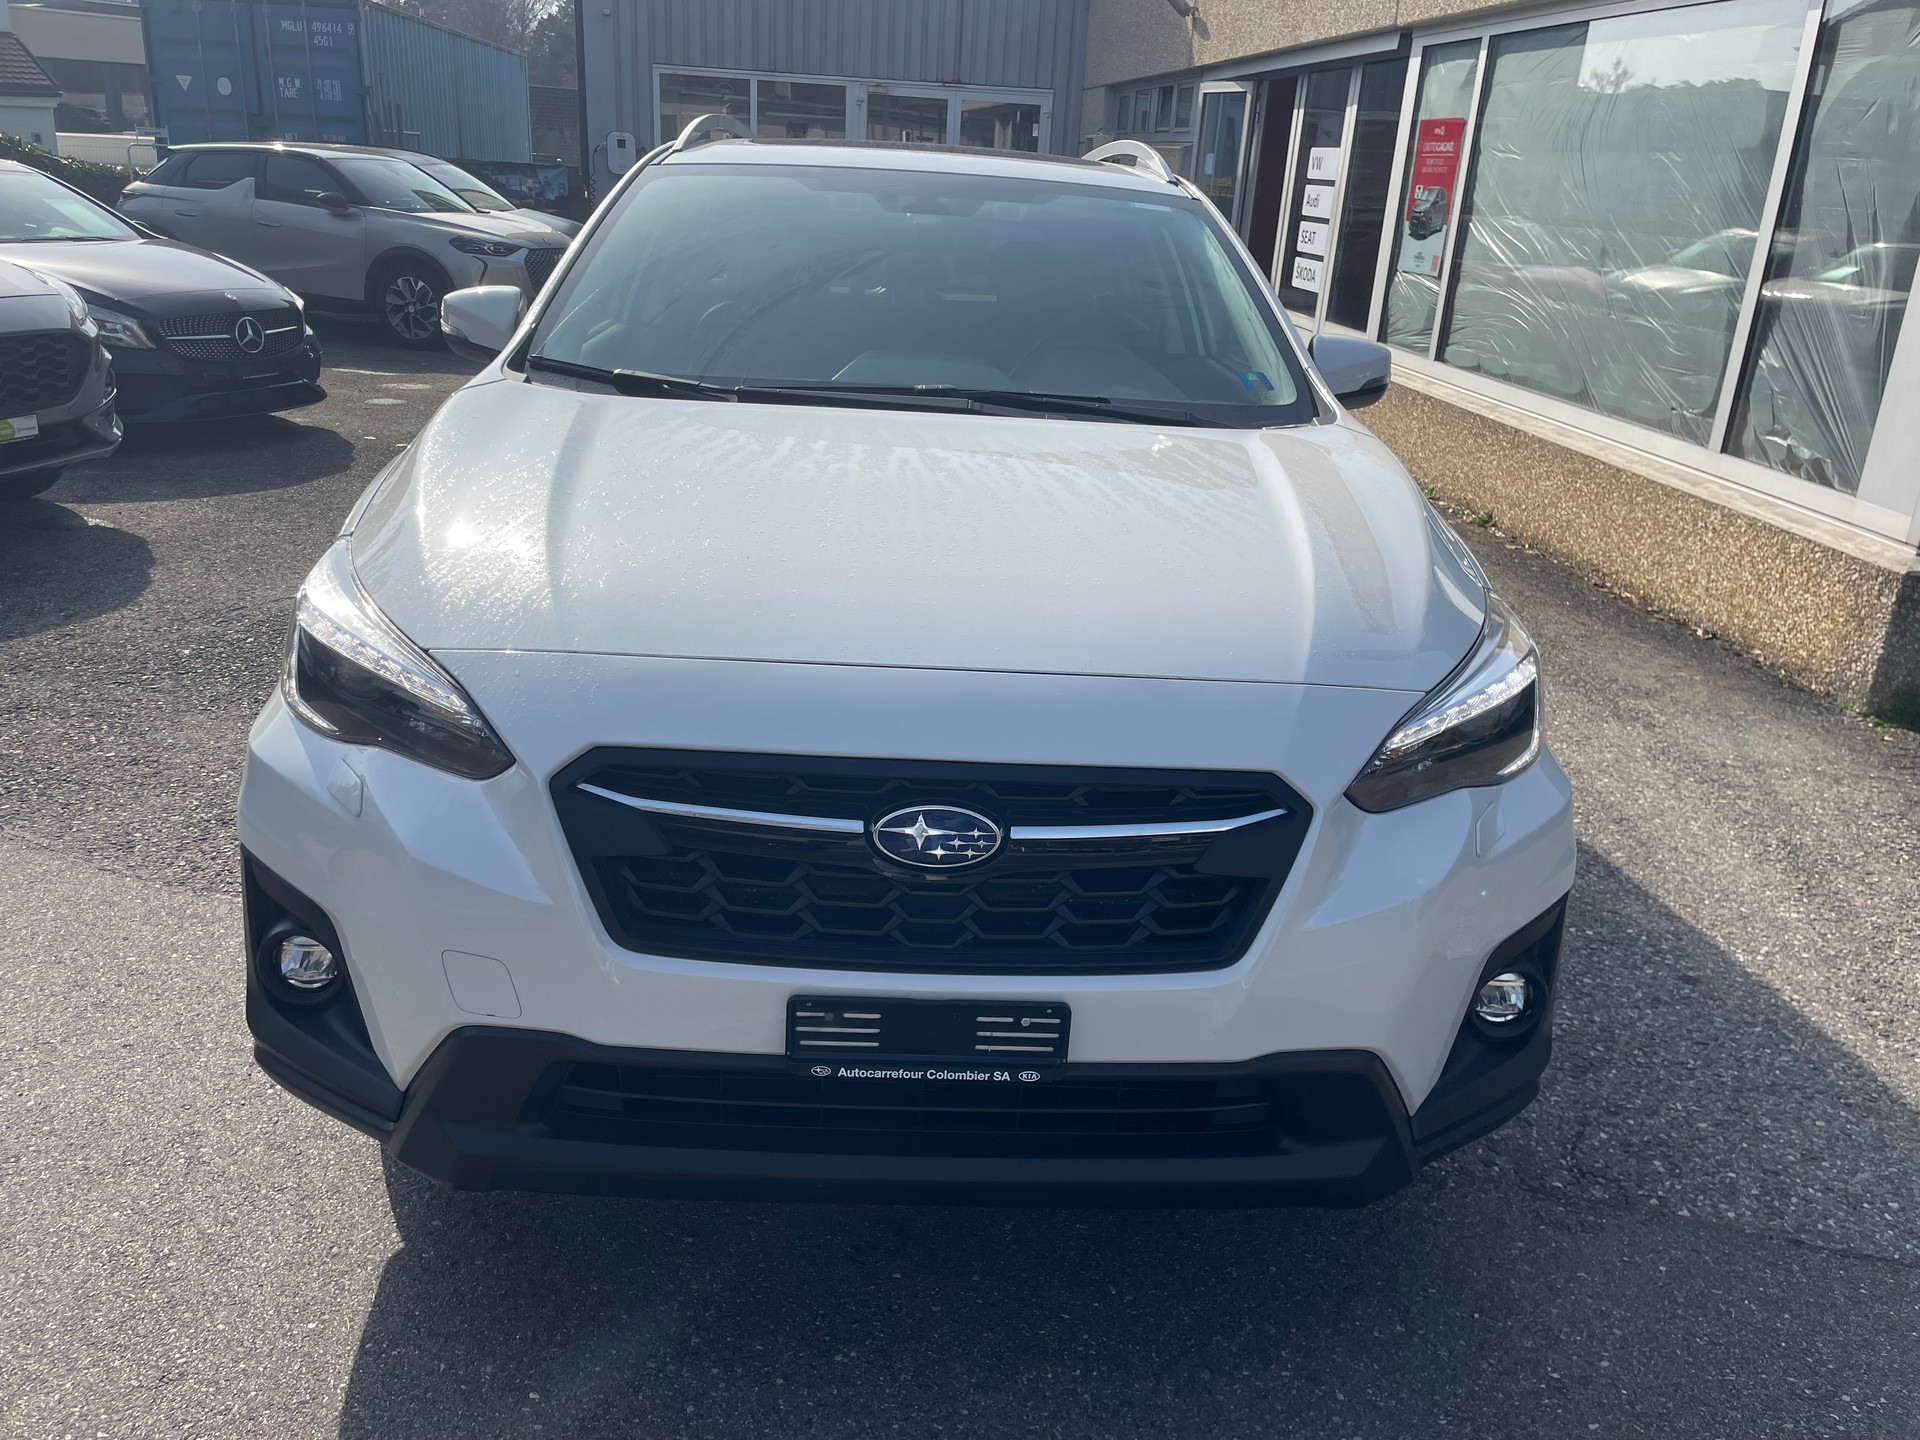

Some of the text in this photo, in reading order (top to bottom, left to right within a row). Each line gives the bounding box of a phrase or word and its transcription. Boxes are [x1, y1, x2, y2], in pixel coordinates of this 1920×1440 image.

[281, 20, 303, 32] MGLU
[311, 21, 342, 34] 496414
[280, 87, 299, 99] TARE
[1311, 156, 1324, 171] VW
[1305, 194, 1320, 208] Audi
[1300, 230, 1316, 245] SEAT
[1295, 262, 1316, 284] ŠKODA
[837, 1067, 1011, 1082] Autocarrefour Colombier SA
[1021, 1072, 1038, 1081] KIA
